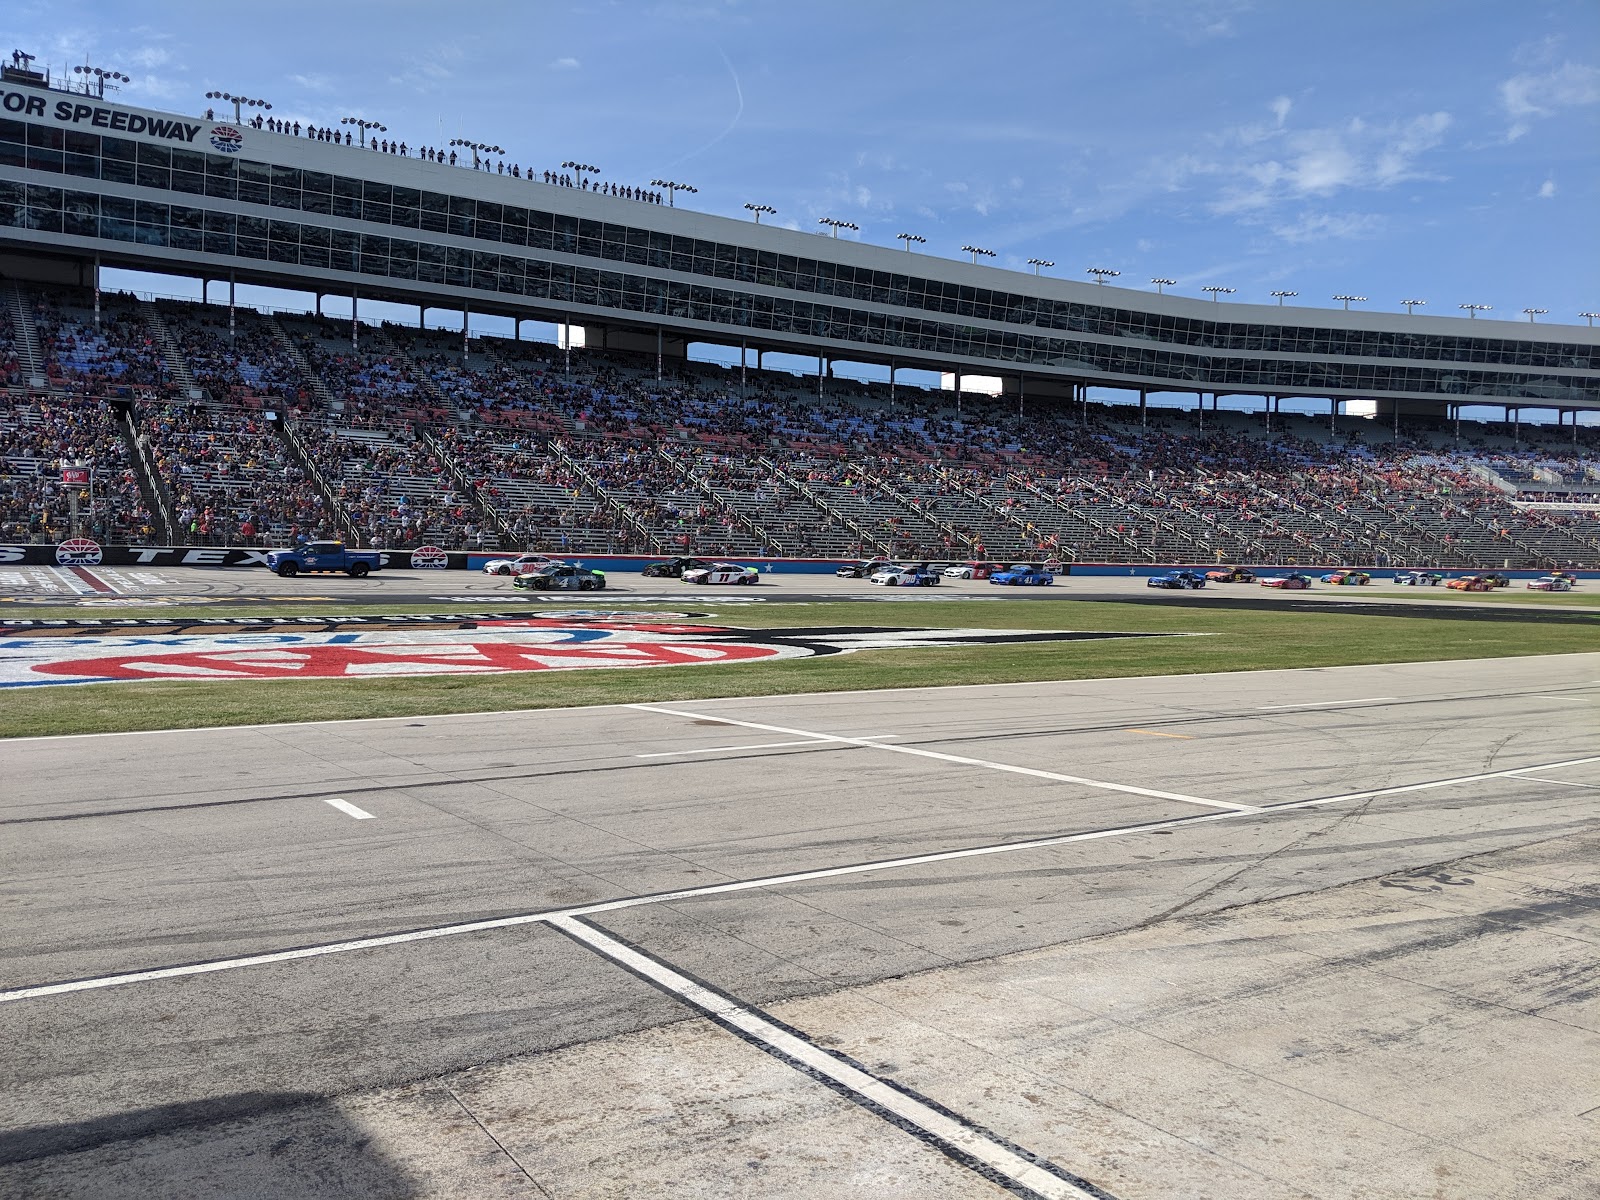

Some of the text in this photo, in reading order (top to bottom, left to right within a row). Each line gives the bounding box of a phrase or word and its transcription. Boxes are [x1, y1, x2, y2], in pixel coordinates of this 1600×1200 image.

[54, 101, 202, 143] SPEEDWAY
[521, 563, 535, 573] 20
[558, 577, 569, 588] 4
[719, 573, 730, 583] 11
[905, 574, 916, 583] 88
[1024, 576, 1033, 584] 41
